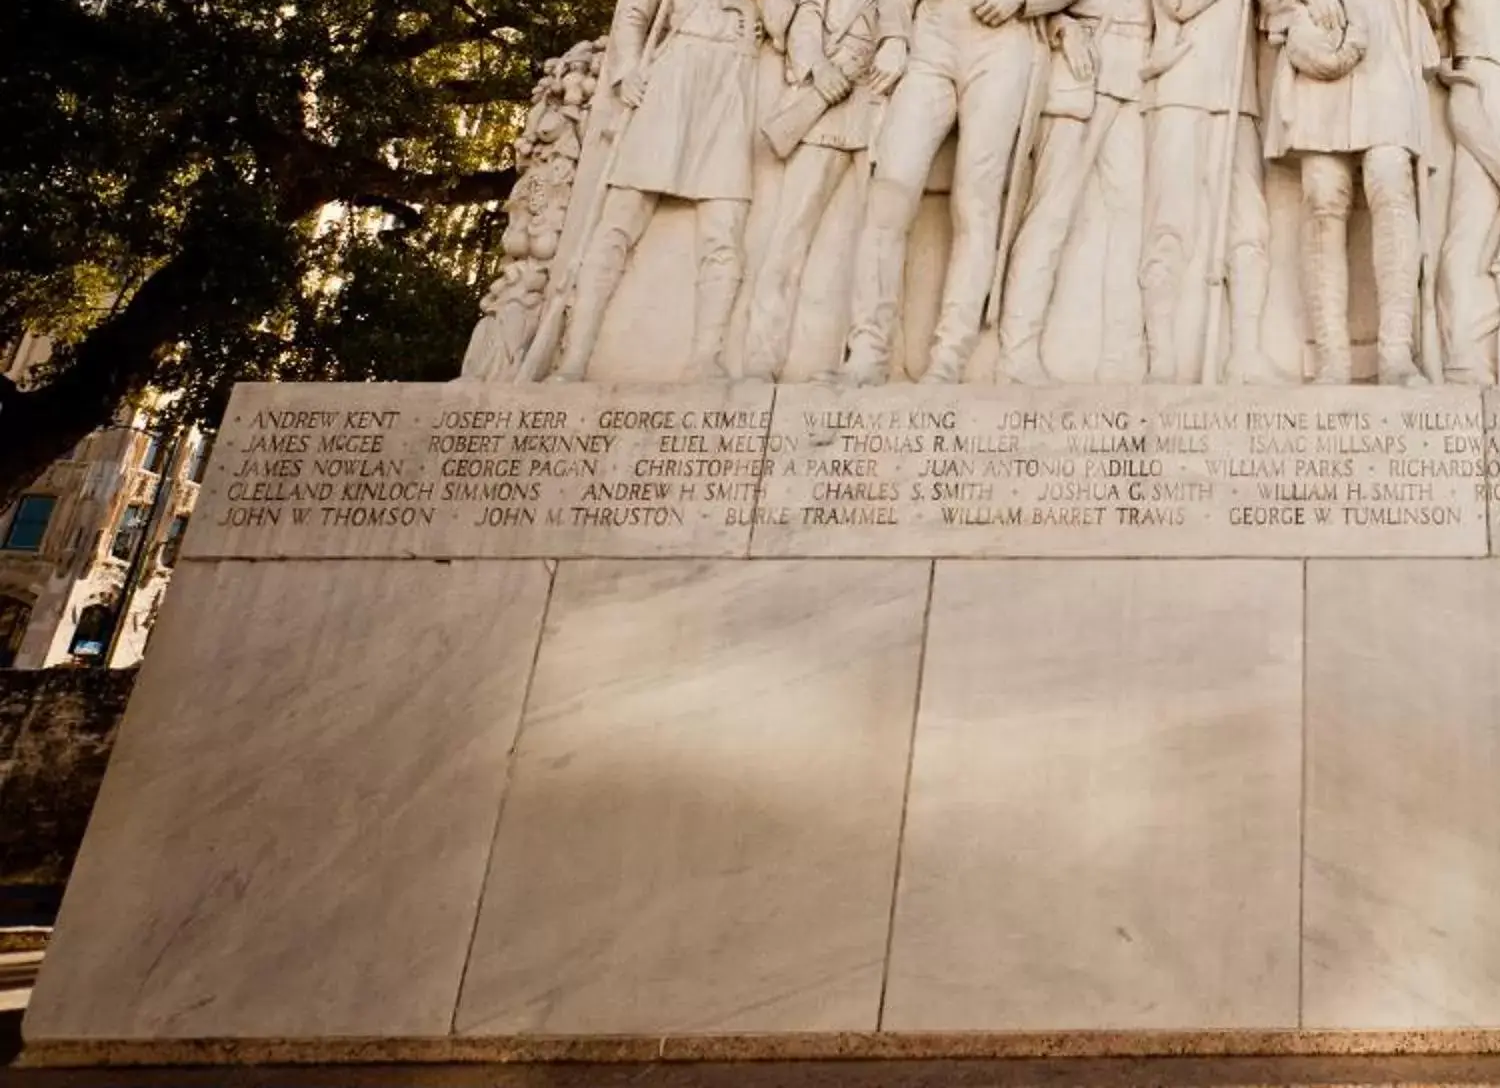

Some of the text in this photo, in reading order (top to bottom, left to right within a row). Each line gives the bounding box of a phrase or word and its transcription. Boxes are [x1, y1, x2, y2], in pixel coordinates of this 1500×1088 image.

[250, 411, 334, 430] ANDREW
[344, 411, 400, 430] KENT
[432, 411, 511, 430] JOSEPH
[519, 411, 567, 430] KERR
[599, 411, 674, 430] GEORGE
[702, 411, 770, 430] KIMBLE
[803, 411, 882, 430] WILLIAM
[909, 411, 956, 430] KING
[997, 412, 1051, 431] JOHN
[1081, 412, 1128, 431] KING
[1159, 412, 1238, 431] WILLIAM
[1247, 412, 1308, 431] IRVINE
[1317, 412, 1370, 431] LEWIS
[1402, 412, 1481, 431] WILLIAM
[242, 435, 311, 453] JAMES
[428, 435, 504, 453] ROBERT
[659, 435, 708, 453] ELIEL
[717, 435, 799, 453] MELTON
[841, 435, 924, 453] THOMAS
[953, 435, 1019, 453] MILLER
[1067, 435, 1146, 453] WILLIAM
[1155, 435, 1208, 453] MILLS
[1250, 435, 1306, 453] ISAAC
[1315, 435, 1407, 453] MILLSAPS
[233, 459, 302, 477] JAMES
[314, 459, 403, 477] NOWLAN
[441, 459, 520, 477] GEORGE
[529, 459, 600, 477] PAGAN
[635, 459, 774, 477] CHRISTOPHER
[806, 459, 879, 477] PARKER
[918, 459, 974, 477] JUAN
[983, 459, 1075, 477] ANTONIO
[1085, 459, 1163, 477] PADILLO
[1205, 459, 1285, 477] WILLIAM
[1295, 459, 1353, 477] PARKS
[227, 482, 333, 501] CLELLAND
[340, 482, 434, 501] KINLOCH
[441, 482, 541, 501] SIMMONS
[582, 482, 671, 501] ANDREW
[704, 482, 767, 501] SMITH
[813, 482, 899, 501] CHARLES
[931, 482, 993, 501] SMITH
[1038, 482, 1120, 501] JOSHUA
[1150, 482, 1213, 501] SMITH
[1258, 482, 1338, 501] WILLIAM
[1371, 482, 1433, 501] SMITH
[218, 507, 279, 526] JOHN
[321, 507, 436, 526] THOMSON
[474, 507, 535, 526] JOHN
[571, 507, 685, 526] THRUSTON
[725, 507, 789, 526] BURKE
[801, 507, 898, 526] TRAMMEL
[941, 507, 1022, 526] WILLIAM
[1032, 508, 1103, 525] BARRET
[1114, 508, 1186, 525] TRAVIS
[1229, 508, 1304, 525] GEORGE
[1341, 508, 1462, 525] TUMLINSON
